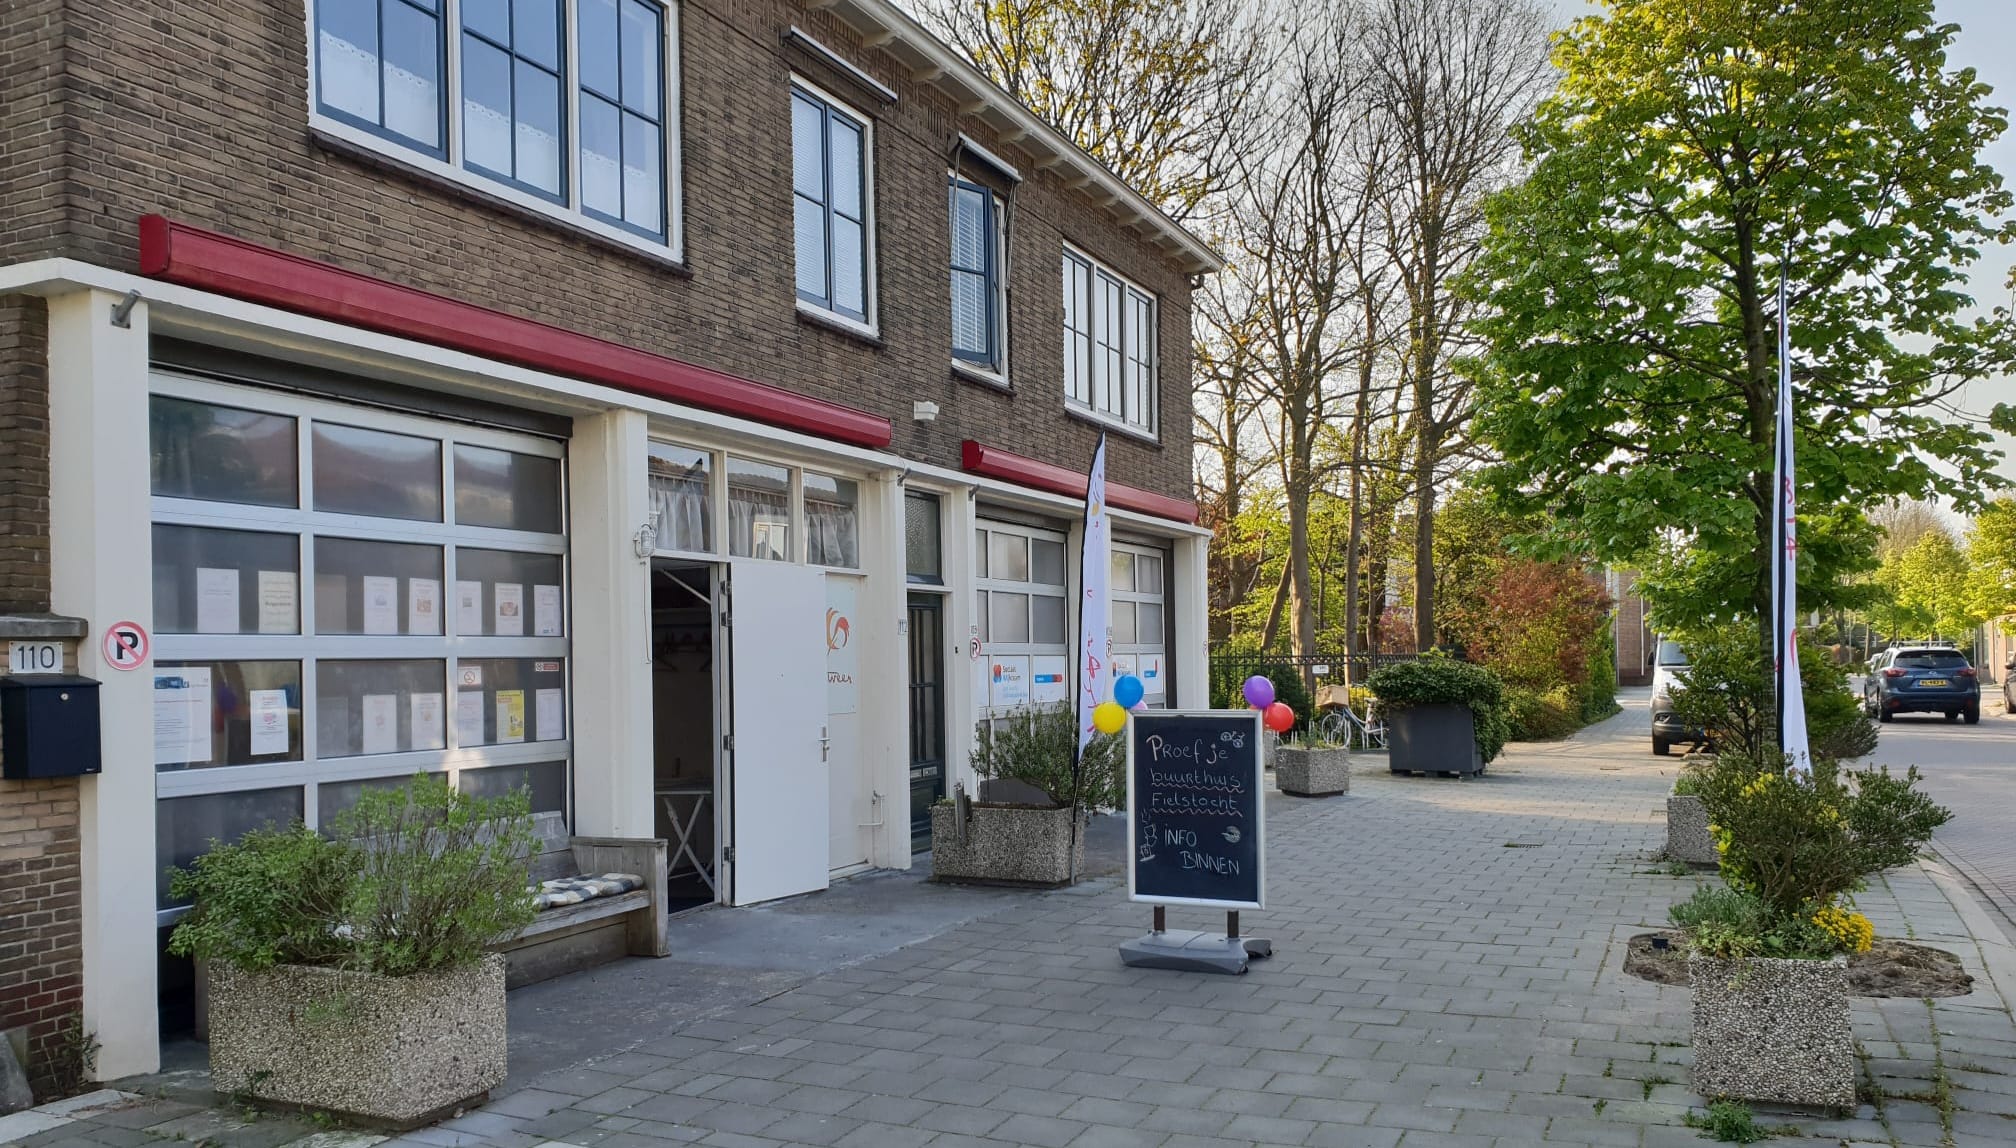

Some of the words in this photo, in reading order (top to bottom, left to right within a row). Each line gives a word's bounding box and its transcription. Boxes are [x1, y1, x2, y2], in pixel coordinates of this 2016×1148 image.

[18, 645, 55, 669] 110
[1206, 743, 1229, 764] je
[1179, 850, 1240, 876] BINNEN
